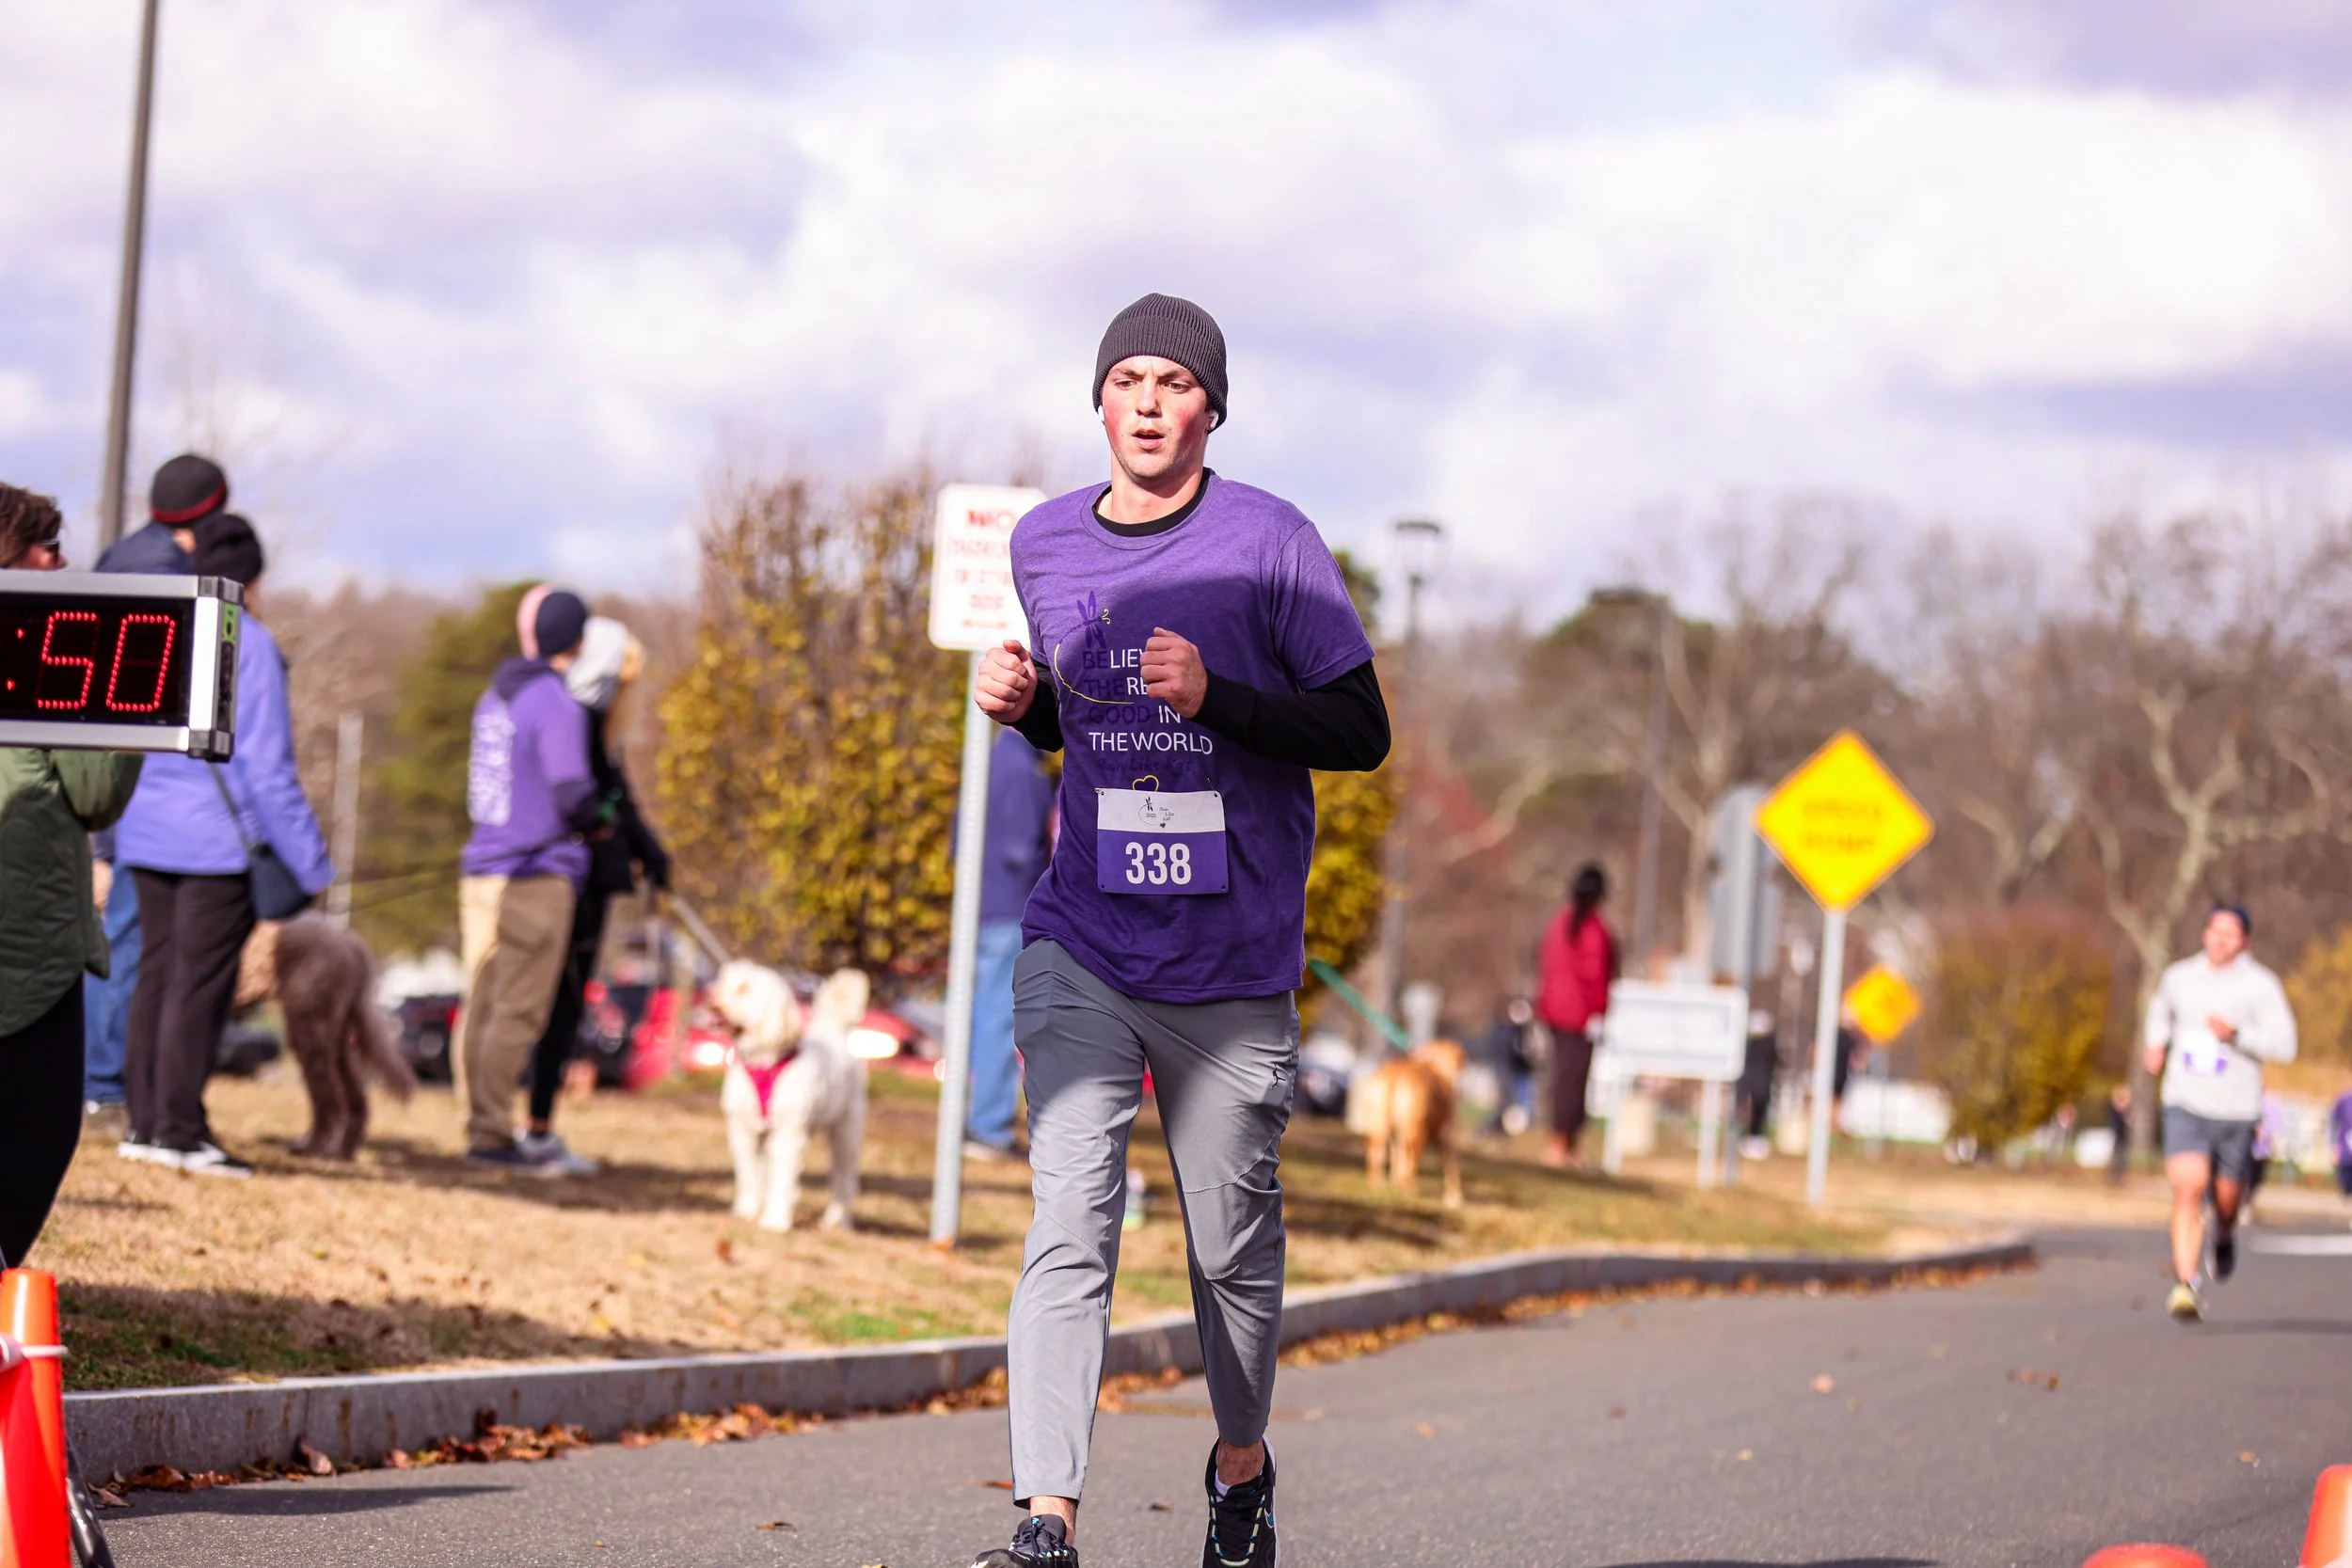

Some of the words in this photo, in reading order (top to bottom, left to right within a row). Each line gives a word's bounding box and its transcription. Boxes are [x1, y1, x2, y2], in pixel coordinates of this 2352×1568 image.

[1083, 648, 1144, 669] BELIE
[1089, 705, 1151, 723] GOOD
[1158, 705, 1182, 723] IN
[1089, 732, 1128, 752] THE
[1131, 732, 1213, 754] WORLD
[1098, 758, 1124, 772] Run
[1130, 757, 1159, 772] Like
[1168, 757, 1192, 772] Kat
[1125, 842, 1192, 885] 338
